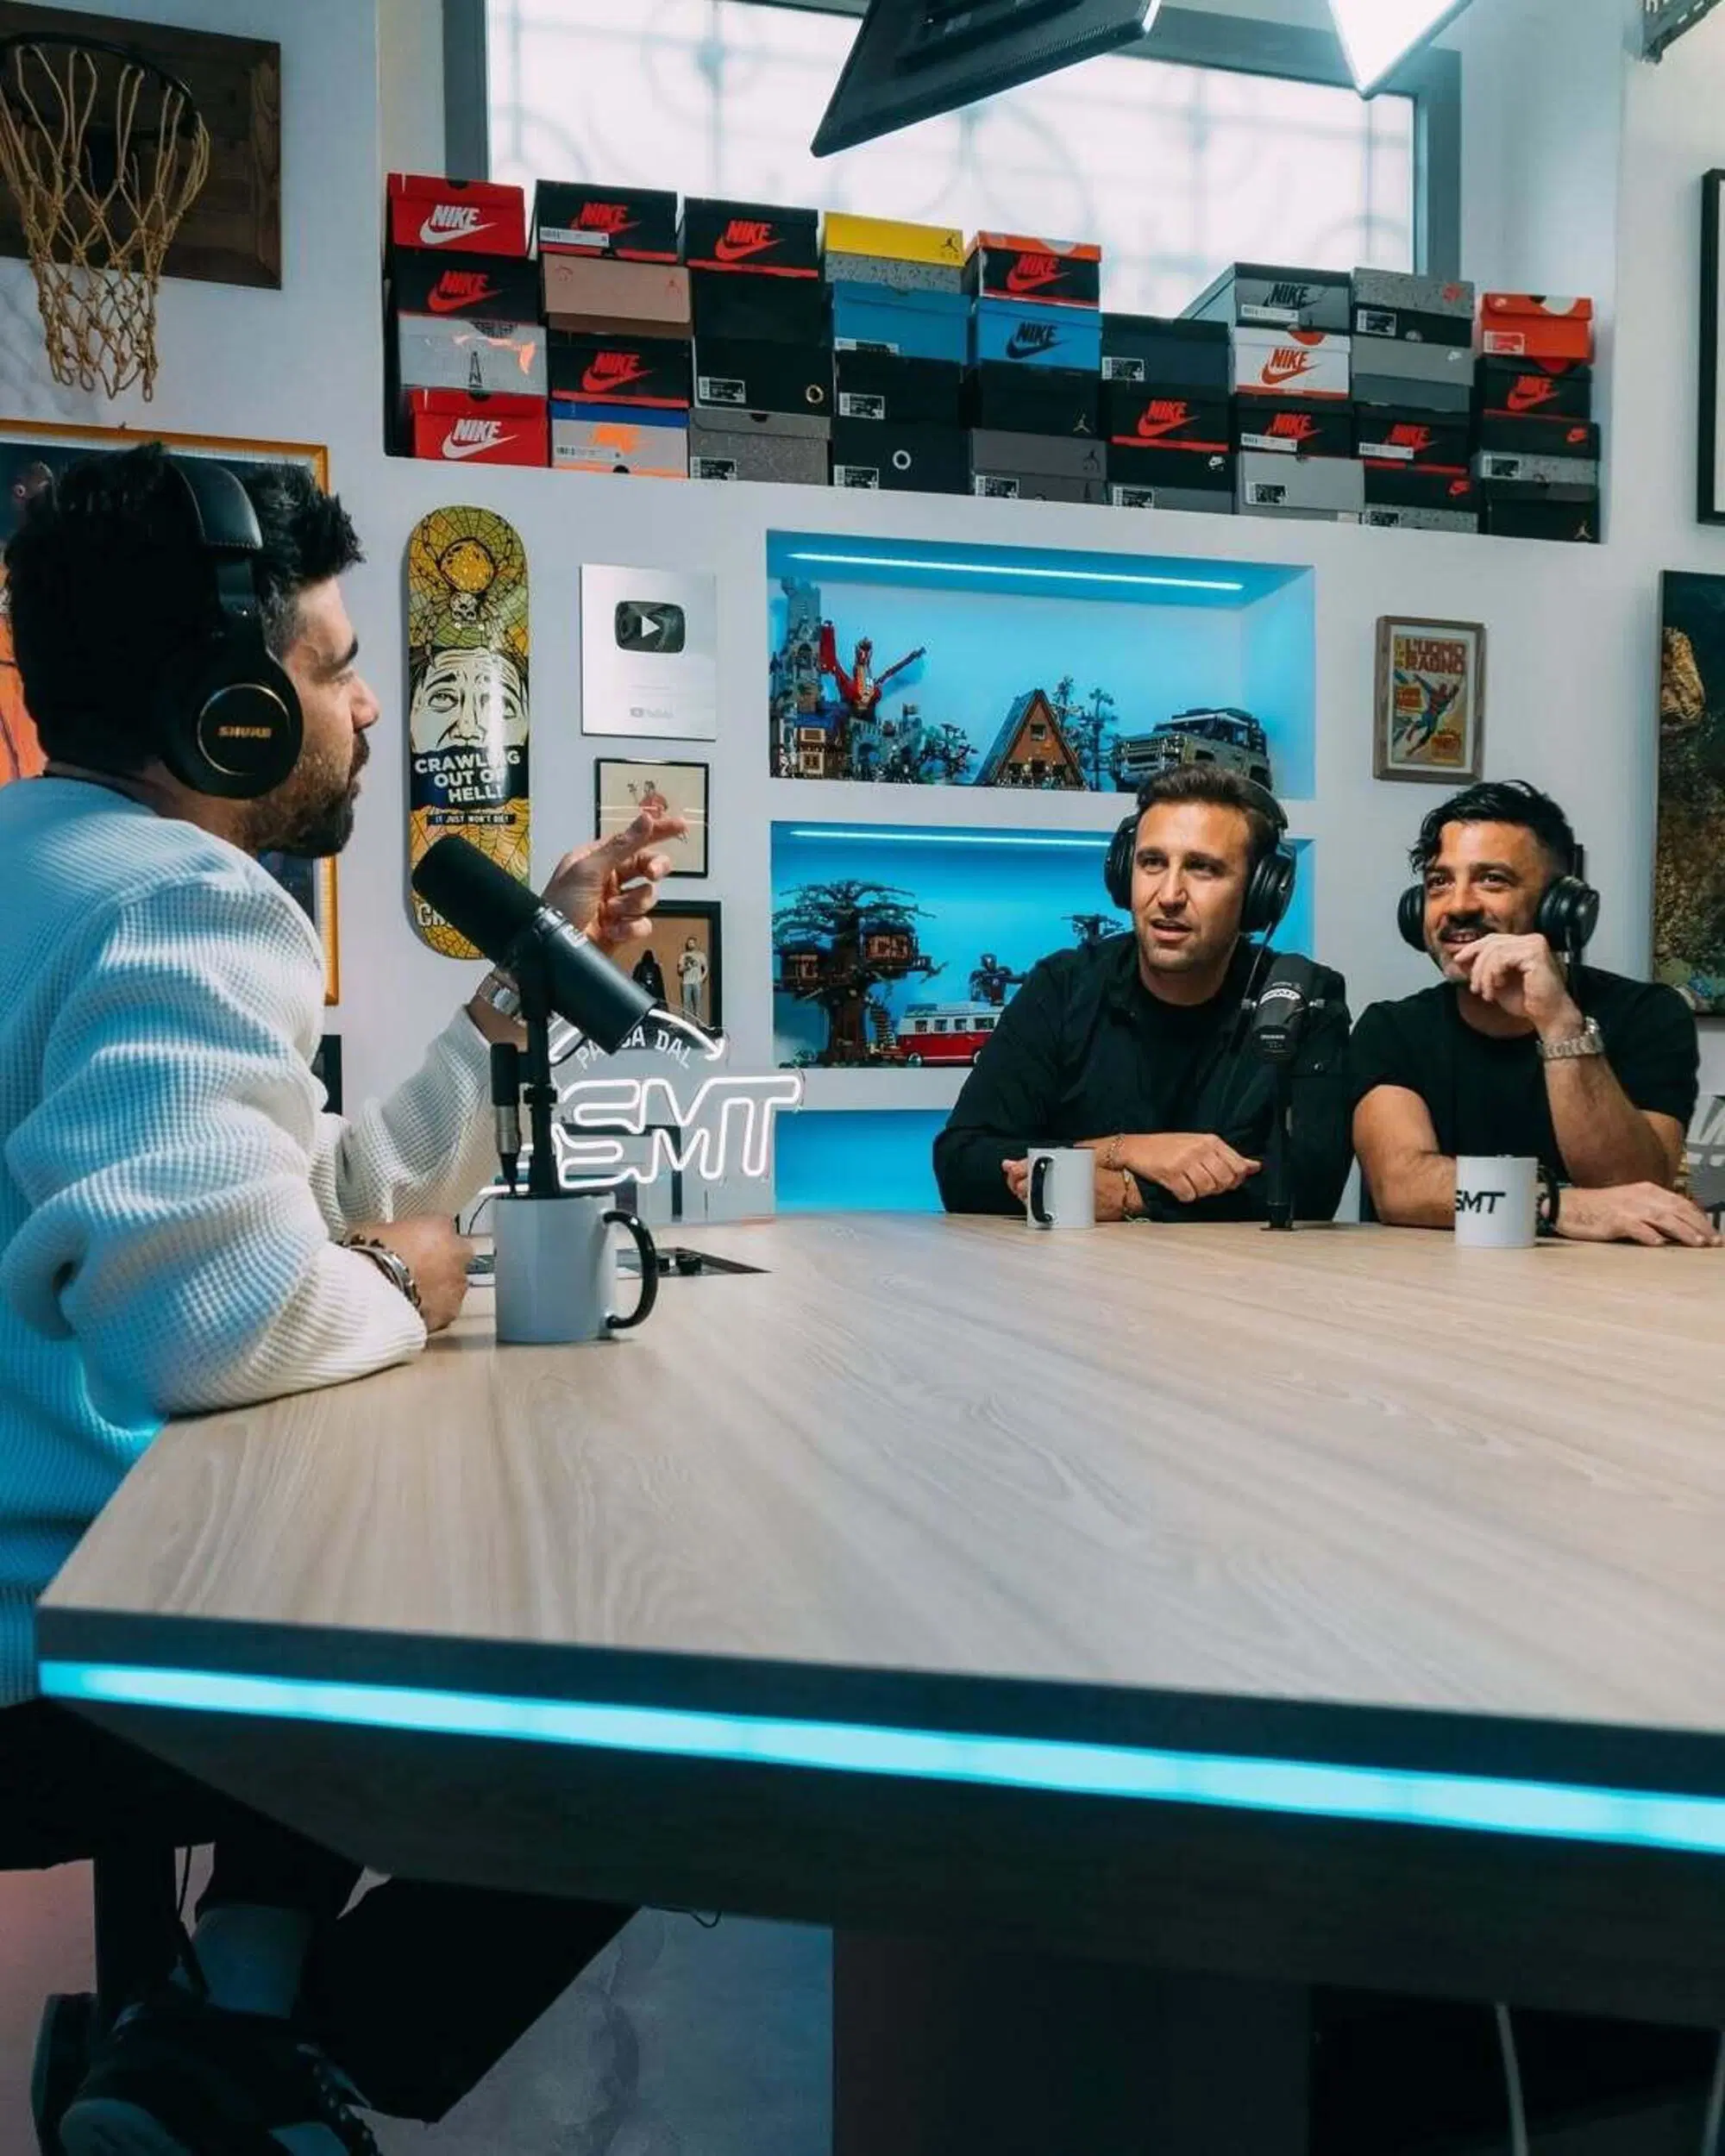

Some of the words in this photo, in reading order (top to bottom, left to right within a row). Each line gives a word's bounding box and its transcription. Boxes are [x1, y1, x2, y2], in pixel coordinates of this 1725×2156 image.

[430, 204, 480, 229] NIKE
[580, 203, 629, 228] NIKE
[726, 219, 773, 244] NIKE
[1017, 254, 1061, 277] NIKE
[440, 270, 489, 295] NIKE
[1270, 283, 1311, 309] NIKE
[1017, 322, 1058, 345] NIKE
[593, 351, 640, 376] NIKE
[1270, 348, 1311, 371] NIKE
[1148, 399, 1189, 422] NIKE
[454, 418, 502, 443] NIKE
[1273, 413, 1313, 436] NIKE
[1389, 423, 1432, 447] NIKE
[415, 749, 521, 774] CRAWLG
[434, 769, 474, 788] OUT
[574, 1025, 647, 1070] PAA
[654, 1029, 691, 1070] DAL
[480, 1075, 802, 1195] SMT
